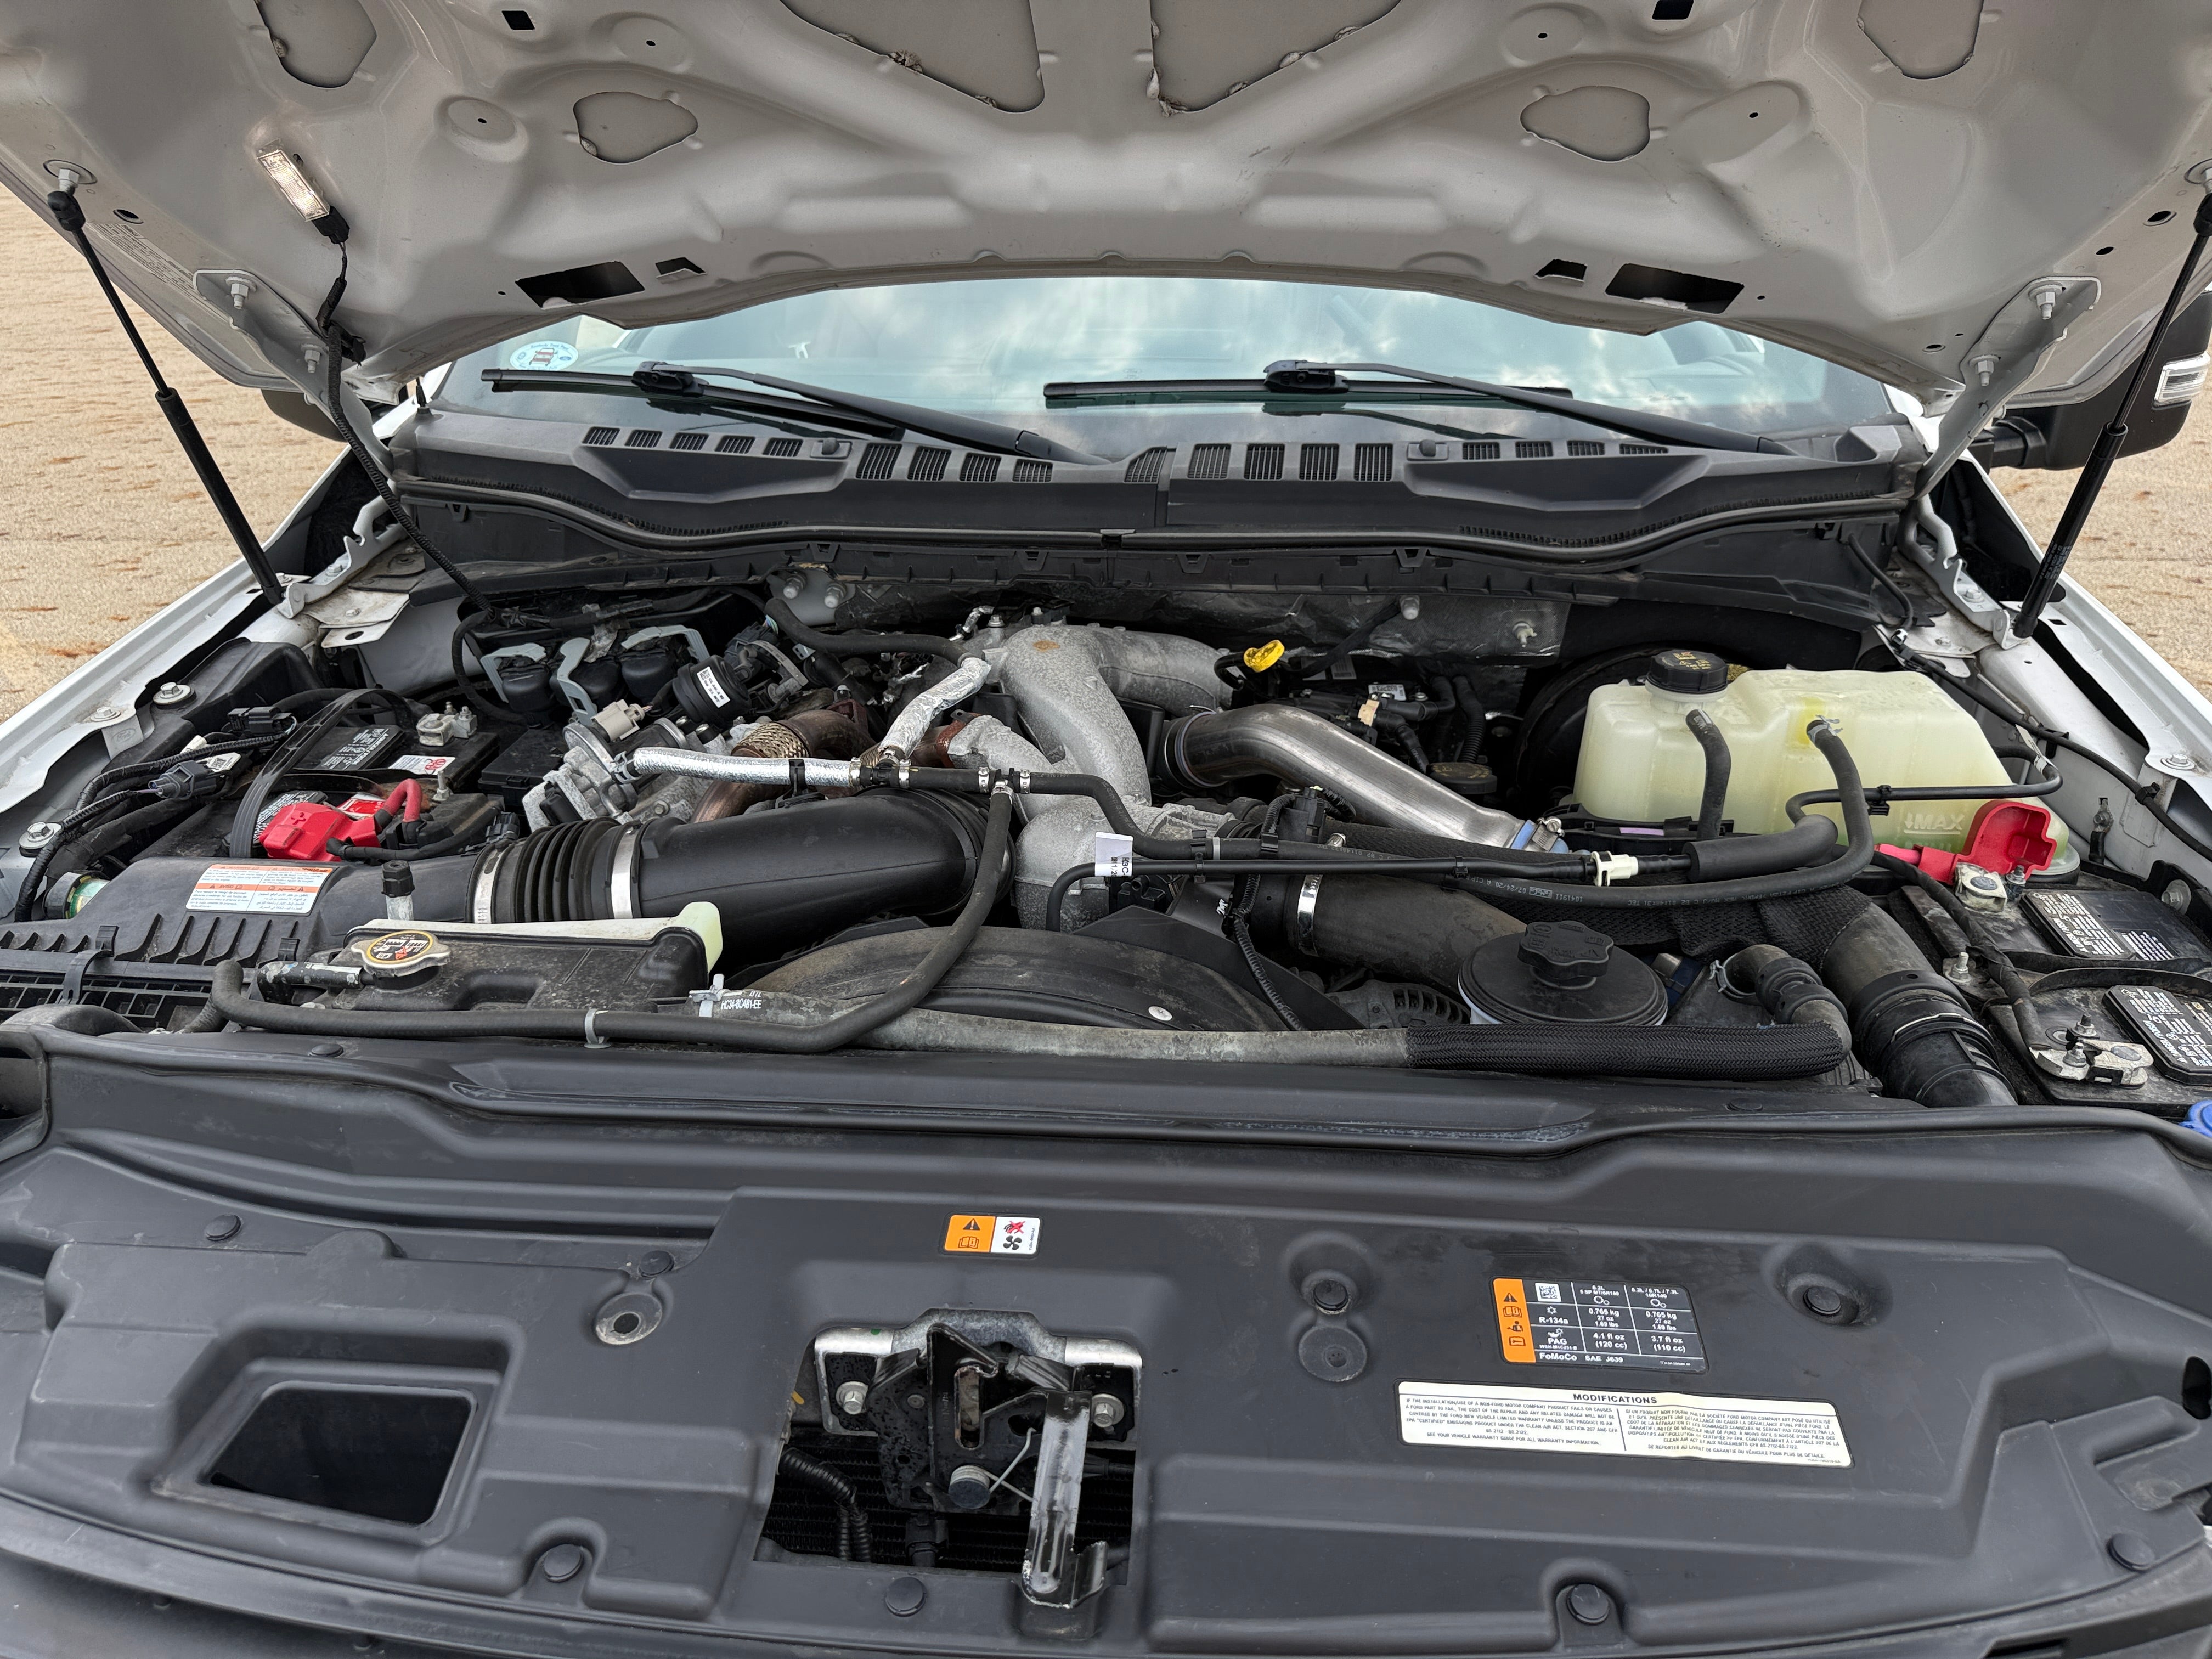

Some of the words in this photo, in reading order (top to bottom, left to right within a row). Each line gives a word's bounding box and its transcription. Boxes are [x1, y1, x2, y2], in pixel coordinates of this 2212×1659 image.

[1914, 813, 1964, 830] MAX
[1496, 882, 1526, 894] 07/24/20
[1556, 894, 1583, 902] 1041911
[1539, 1352, 1577, 1361] FoMoCo
[1572, 1392, 1657, 1405] MODIFICATIONS
